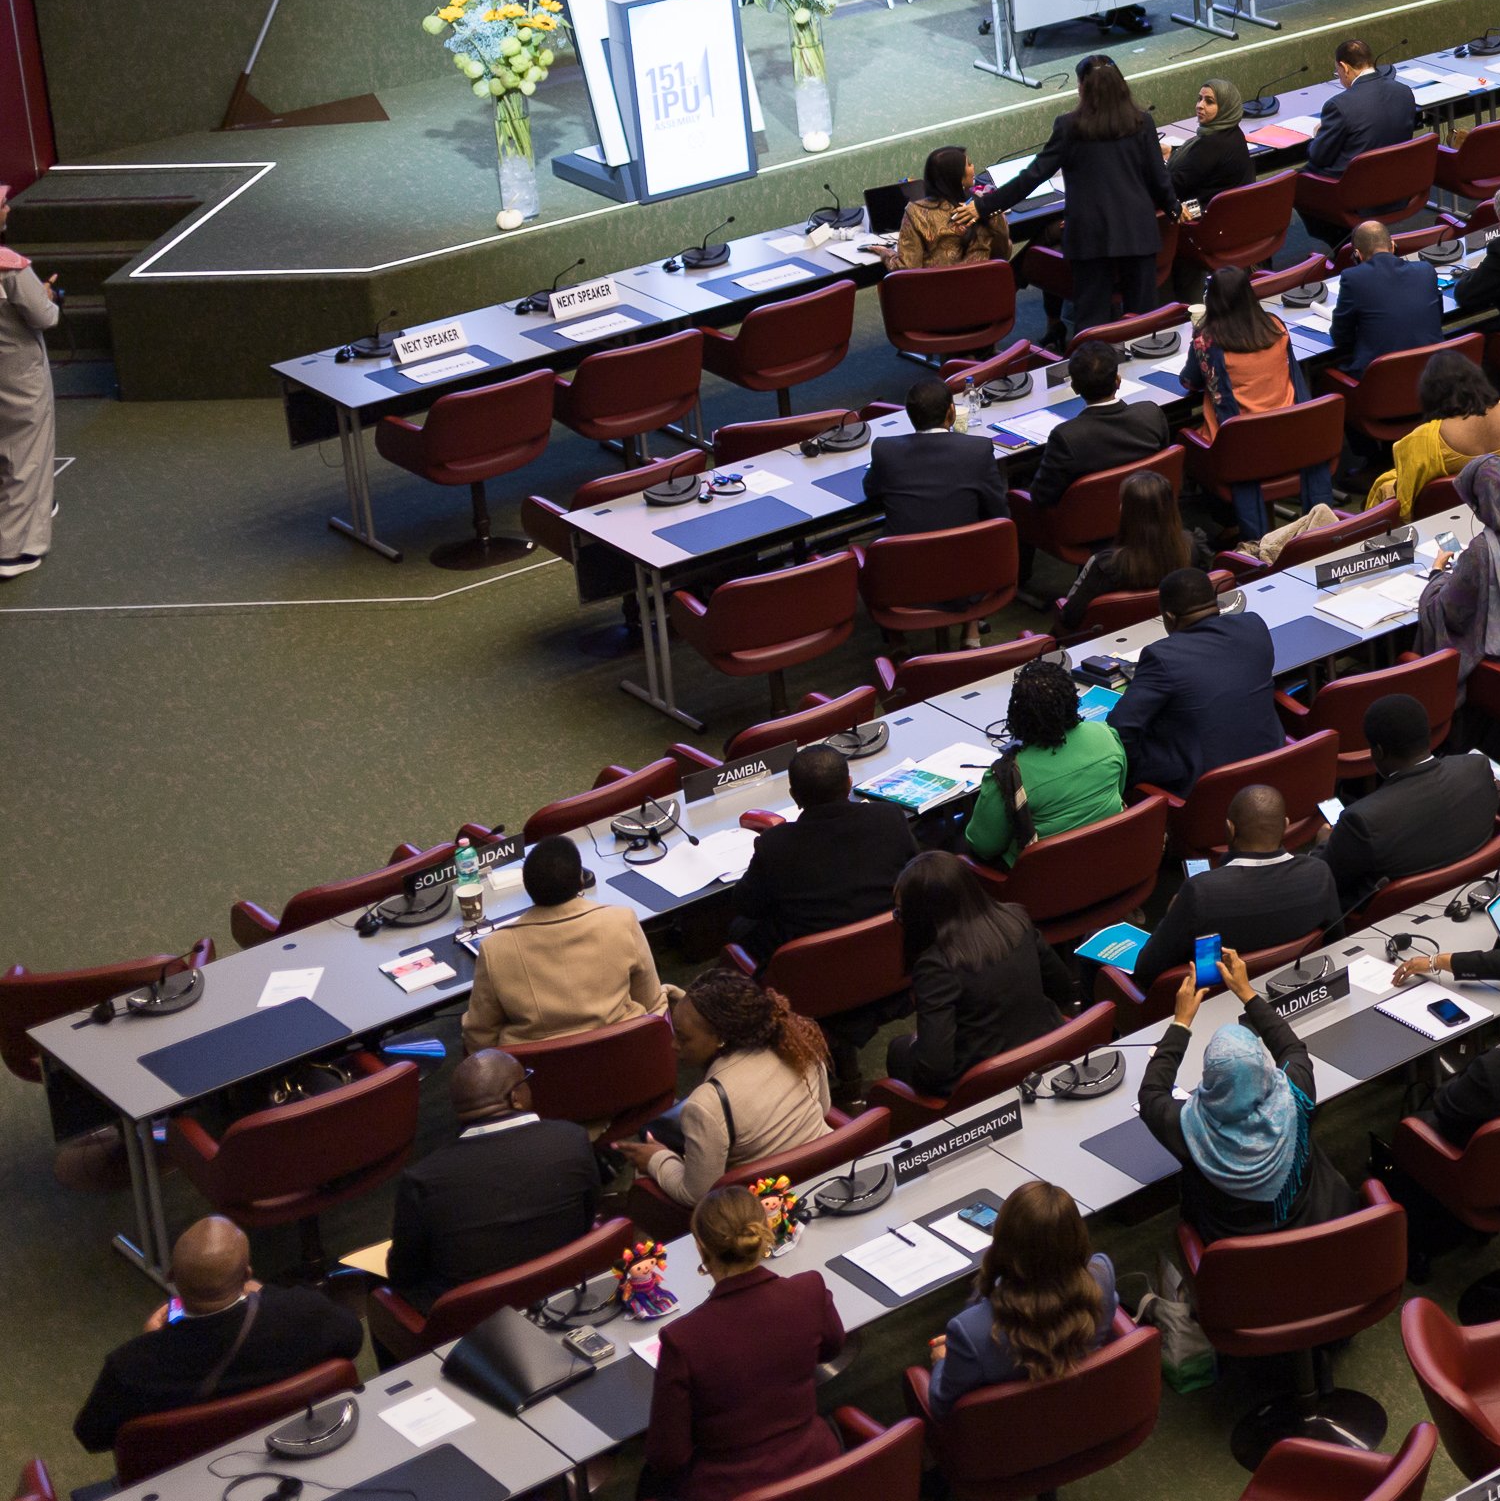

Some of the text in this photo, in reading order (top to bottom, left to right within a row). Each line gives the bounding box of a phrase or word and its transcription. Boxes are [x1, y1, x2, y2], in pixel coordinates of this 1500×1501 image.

[652, 84, 701, 121] IPU
[654, 114, 701, 131] ASSEMBLY
[556, 284, 612, 309] NEXT SPEAKER
[401, 328, 460, 355] NEXT SPEAKER
[1330, 551, 1400, 579] MAURITANIA
[716, 760, 767, 786] ZAMBIA
[477, 843, 516, 867] UDAN
[1275, 985, 1328, 1018] ALDIVES
[898, 1110, 1018, 1174] RUSSIAN FEDERATION
